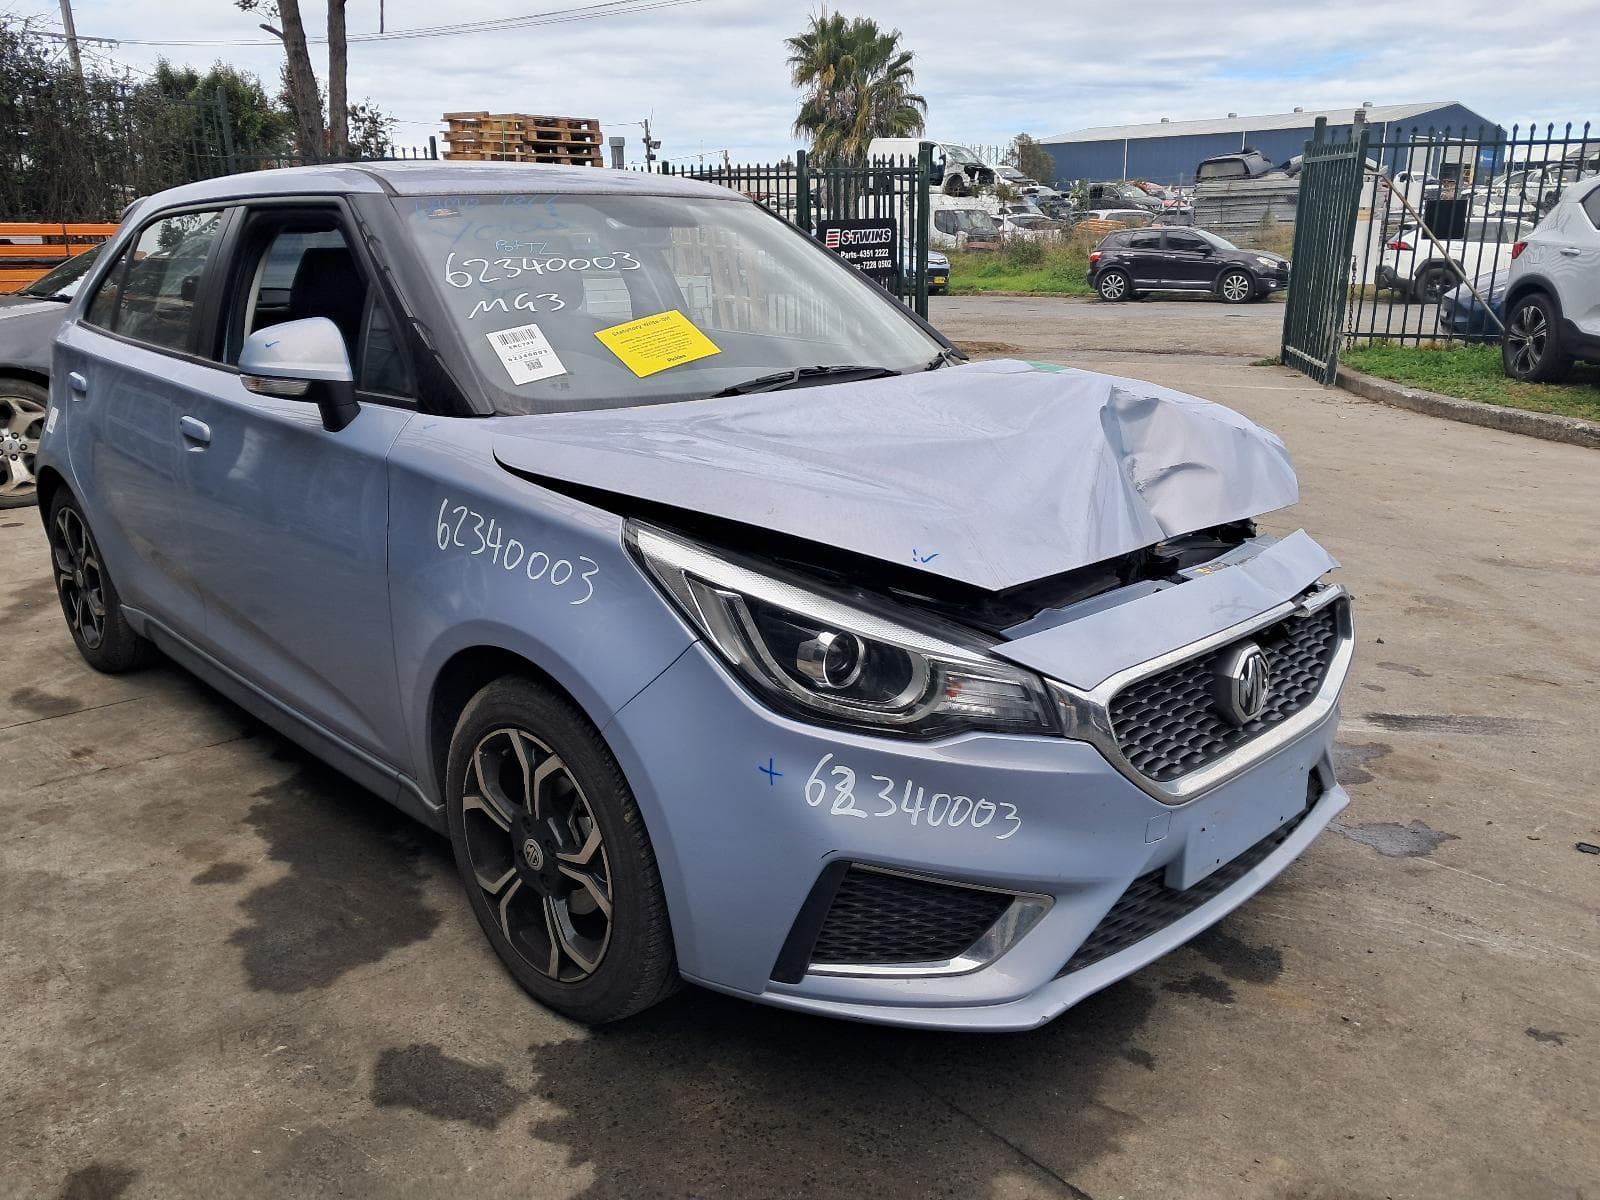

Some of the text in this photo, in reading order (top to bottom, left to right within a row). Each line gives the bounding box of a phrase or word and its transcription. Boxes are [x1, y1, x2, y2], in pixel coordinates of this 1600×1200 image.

[445, 251, 641, 288] 62340003
[468, 292, 566, 320] MG3
[436, 498, 599, 605] 62340003
